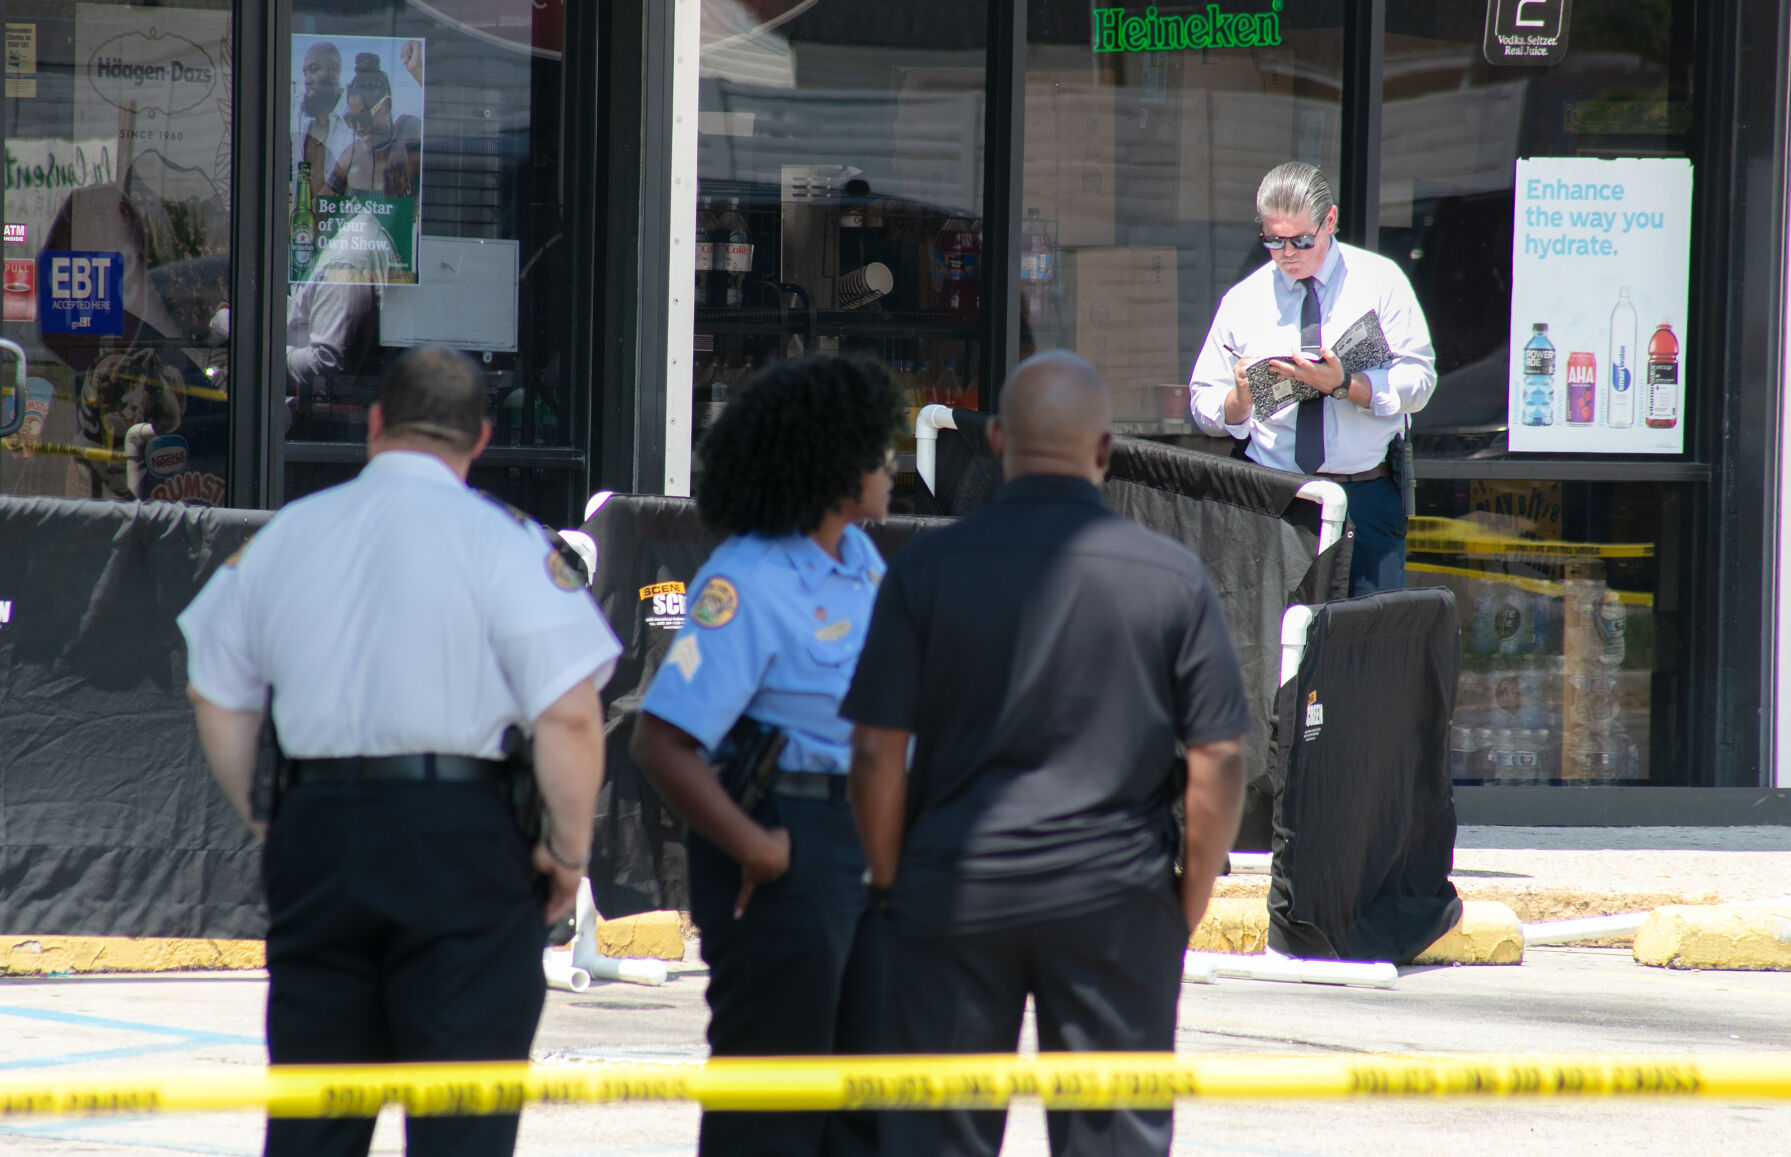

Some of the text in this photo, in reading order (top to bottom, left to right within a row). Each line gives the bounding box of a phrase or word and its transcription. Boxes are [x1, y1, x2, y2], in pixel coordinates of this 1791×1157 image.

[120, 129, 184, 141] SINCE 1960
[1526, 179, 1625, 201] Enhance
[318, 199, 393, 215] Be the Star
[318, 217, 367, 232] of Your
[1525, 206, 1664, 233] the way you
[3, 225, 25, 236] ATM
[317, 236, 349, 250] Own
[1524, 233, 1619, 260] hydrate.
[4, 263, 29, 273] PULL
[52, 257, 111, 299] EBT
[52, 301, 111, 310] ACCEPTED HERE
[1568, 366, 1594, 384] AHA
